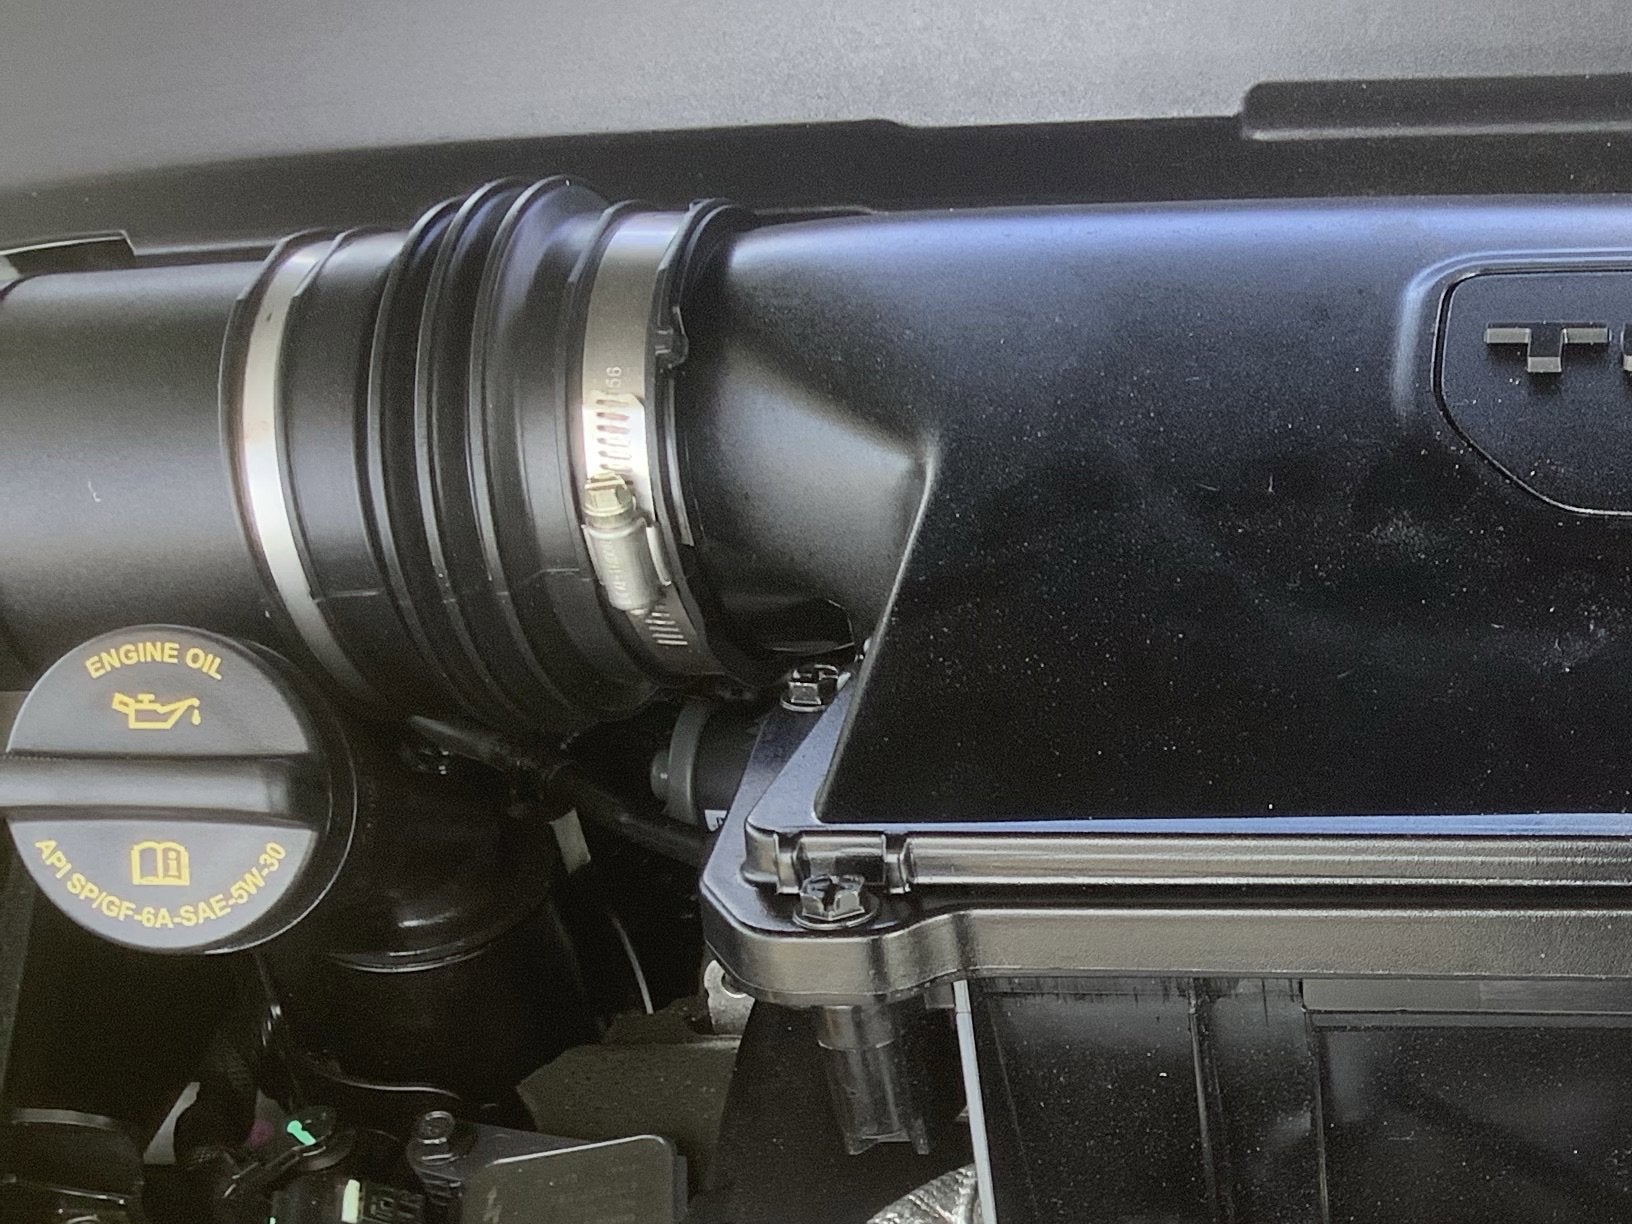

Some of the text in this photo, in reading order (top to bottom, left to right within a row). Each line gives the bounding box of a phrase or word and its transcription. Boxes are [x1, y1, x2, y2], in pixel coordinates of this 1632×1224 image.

[84, 642, 224, 681] ENGINE OIL
[35, 839, 72, 879] API
